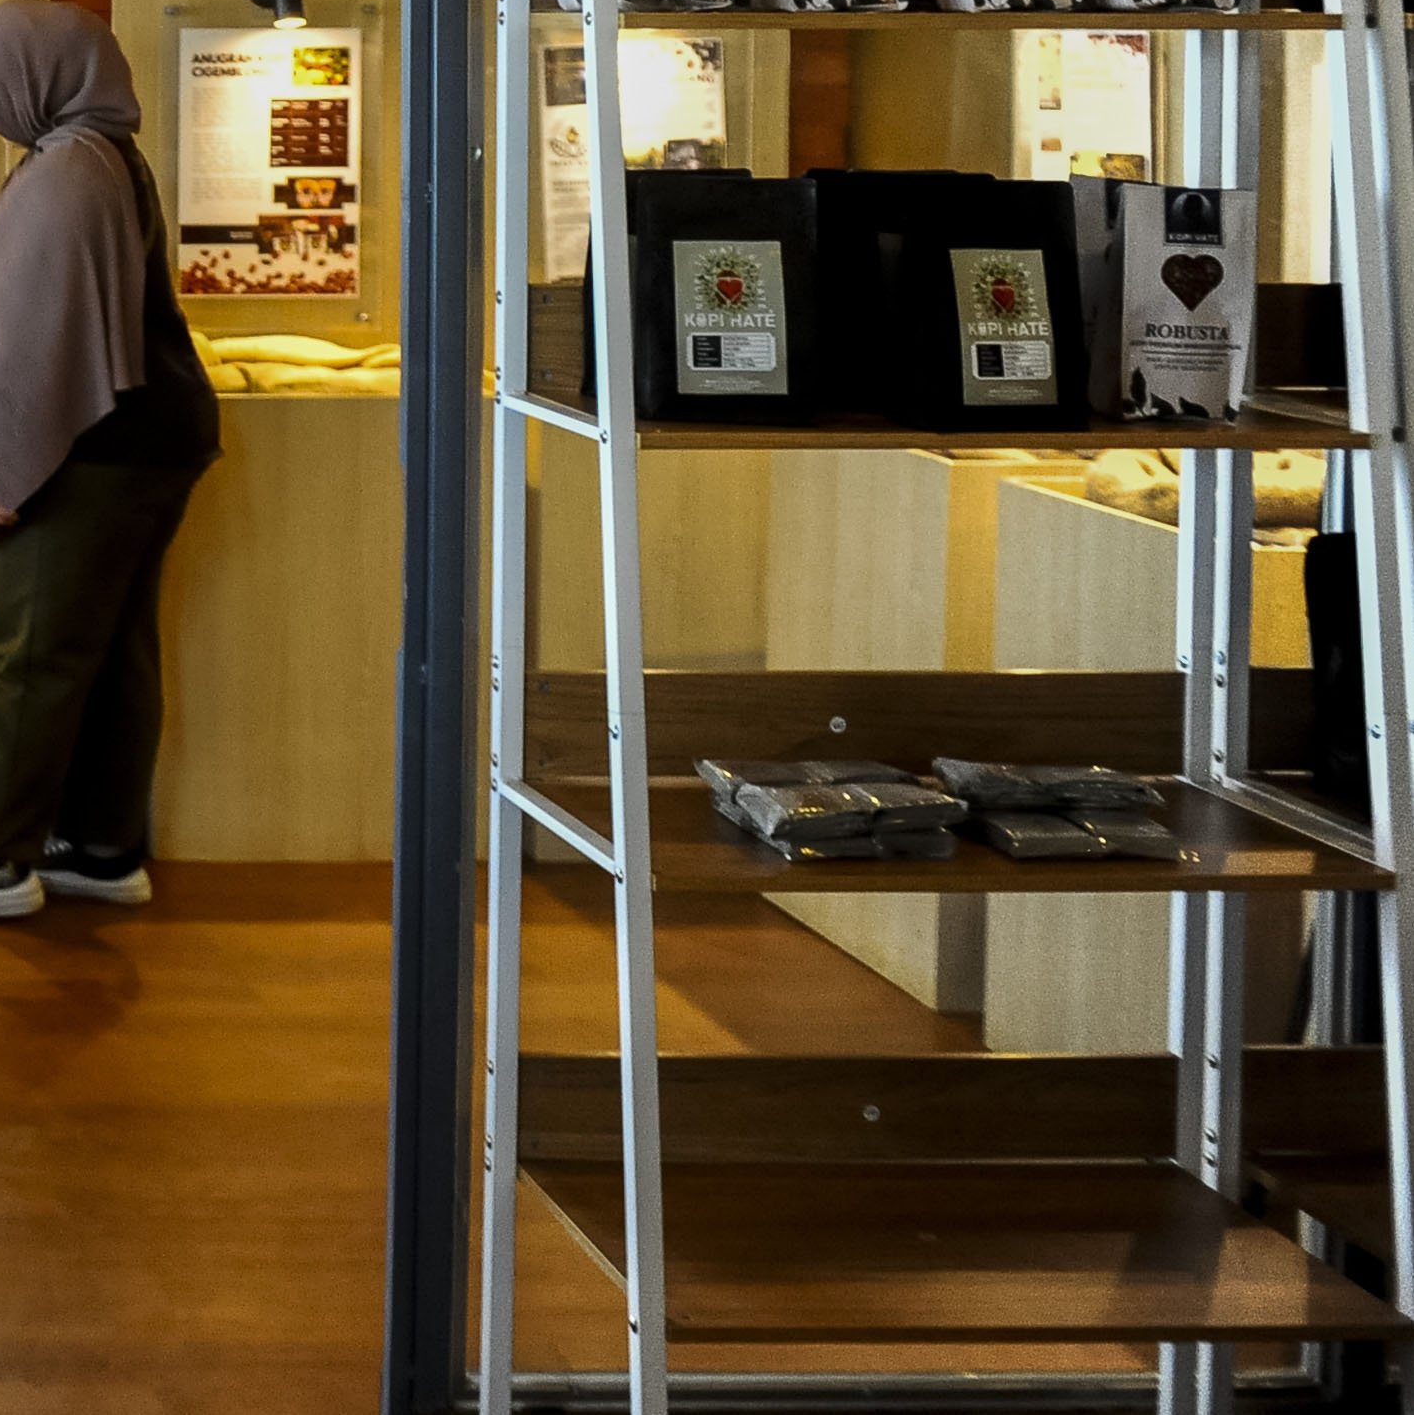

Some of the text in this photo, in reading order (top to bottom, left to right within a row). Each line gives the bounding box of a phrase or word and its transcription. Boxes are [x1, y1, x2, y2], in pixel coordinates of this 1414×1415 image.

[684, 313, 725, 328] KOPI
[967, 322, 1003, 336] KOPI
[1145, 323, 1229, 341] ROBUSTA
